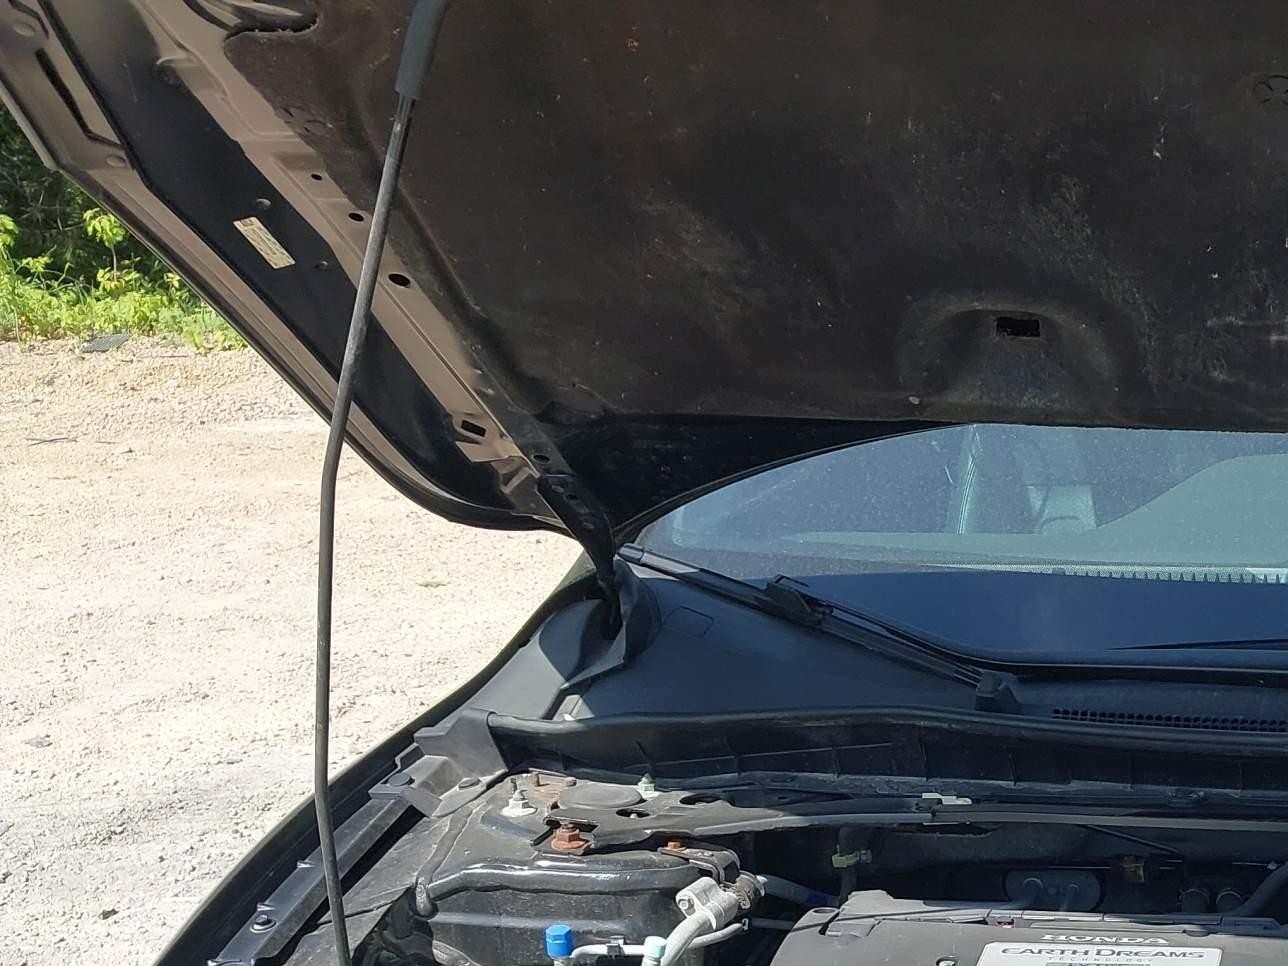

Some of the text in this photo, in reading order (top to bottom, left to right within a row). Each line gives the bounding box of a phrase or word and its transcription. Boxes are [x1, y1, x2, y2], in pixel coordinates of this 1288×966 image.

[1040, 934, 1171, 944] HONDA
[1001, 947, 1206, 959] EARTH DREAMS
